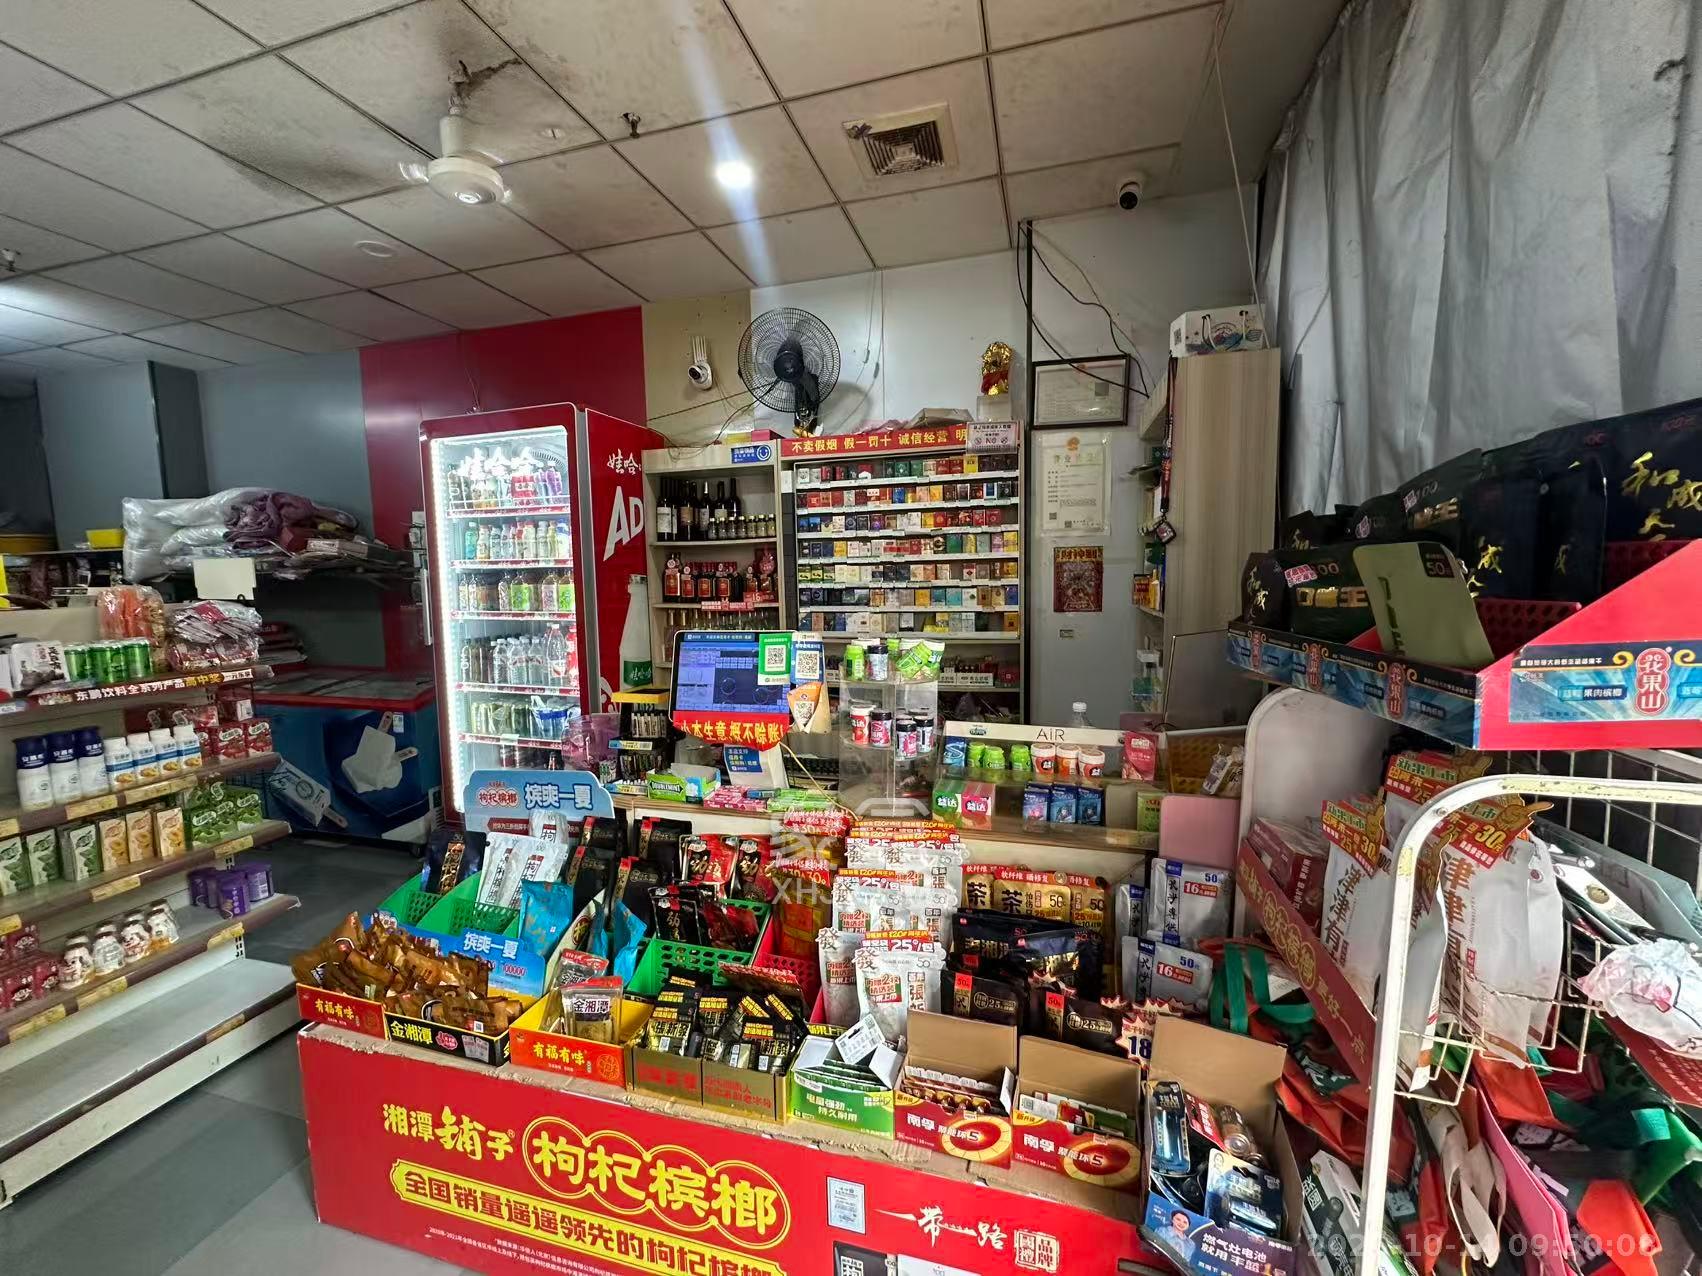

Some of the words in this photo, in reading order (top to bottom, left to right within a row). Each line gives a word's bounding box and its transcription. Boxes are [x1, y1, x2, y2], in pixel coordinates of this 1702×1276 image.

[792, 440, 837, 452] 不卖假烟
[844, 435, 891, 449] 假一罚十
[898, 430, 948, 444] 诚信经营
[607, 449, 641, 474] 娃哈
[604, 485, 644, 562] AD
[1639, 654, 1666, 710] 花果山
[478, 789, 518, 804] 枸杞槟榔
[525, 783, 592, 809] 槟爽一夏
[937, 797, 958, 808] 益达
[966, 801, 986, 812] 益达
[1474, 824, 1503, 848] 30
[1184, 881, 1200, 894] 16
[1204, 873, 1218, 882] 50
[967, 881, 987, 906] 茶
[1002, 889, 1023, 914] 茶
[464, 933, 518, 958] 槟爽一夏
[818, 928, 839, 950] 發
[854, 948, 880, 970] 發
[1158, 963, 1173, 976] 16
[1180, 956, 1195, 968] 50
[314, 999, 356, 1020] 有福有味
[573, 998, 611, 1014] 金湘潭
[390, 1020, 434, 1046] 金湘潭
[1083, 1019, 1097, 1030] 25
[532, 1042, 586, 1067] 有福有味
[817, 1105, 858, 1123] 持久耐用
[907, 1113, 936, 1131] 南孚
[1016, 1113, 1036, 1122] 新升级
[382, 1103, 515, 1162] 湘潭铺子
[1023, 1133, 1055, 1152] 南孚
[1057, 1146, 1104, 1166] 聚能环5
[531, 1130, 778, 1236] 枸杞槟榔
[872, 1205, 1008, 1250] 一带一路
[1200, 1242, 1228, 1262] 就用
[1202, 1233, 1267, 1263] 燃气灶电池
